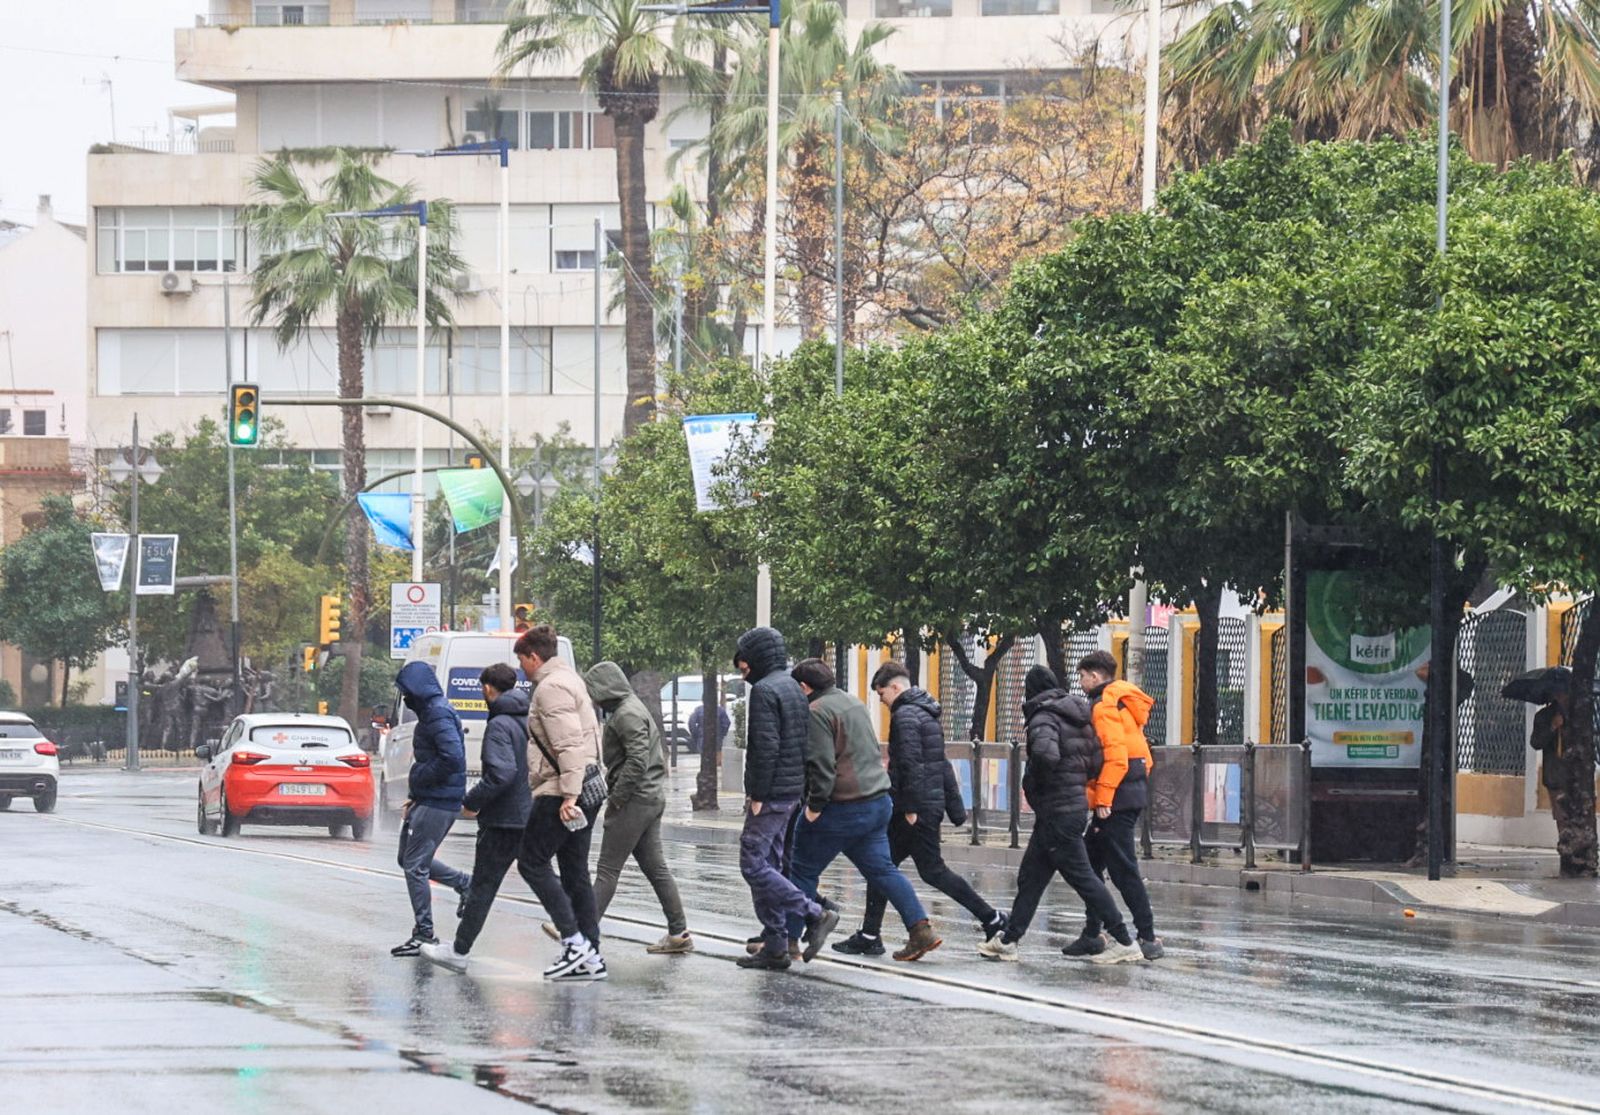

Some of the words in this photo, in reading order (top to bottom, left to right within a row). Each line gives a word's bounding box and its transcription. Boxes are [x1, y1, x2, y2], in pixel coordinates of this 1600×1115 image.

[1356, 644, 1391, 658] kéfir
[1330, 689, 1341, 700] UN
[1344, 686, 1368, 700] KÉFIR
[1371, 689, 1382, 700] DE
[1384, 689, 1418, 700] VERDAD
[1314, 703, 1351, 720] TIENE
